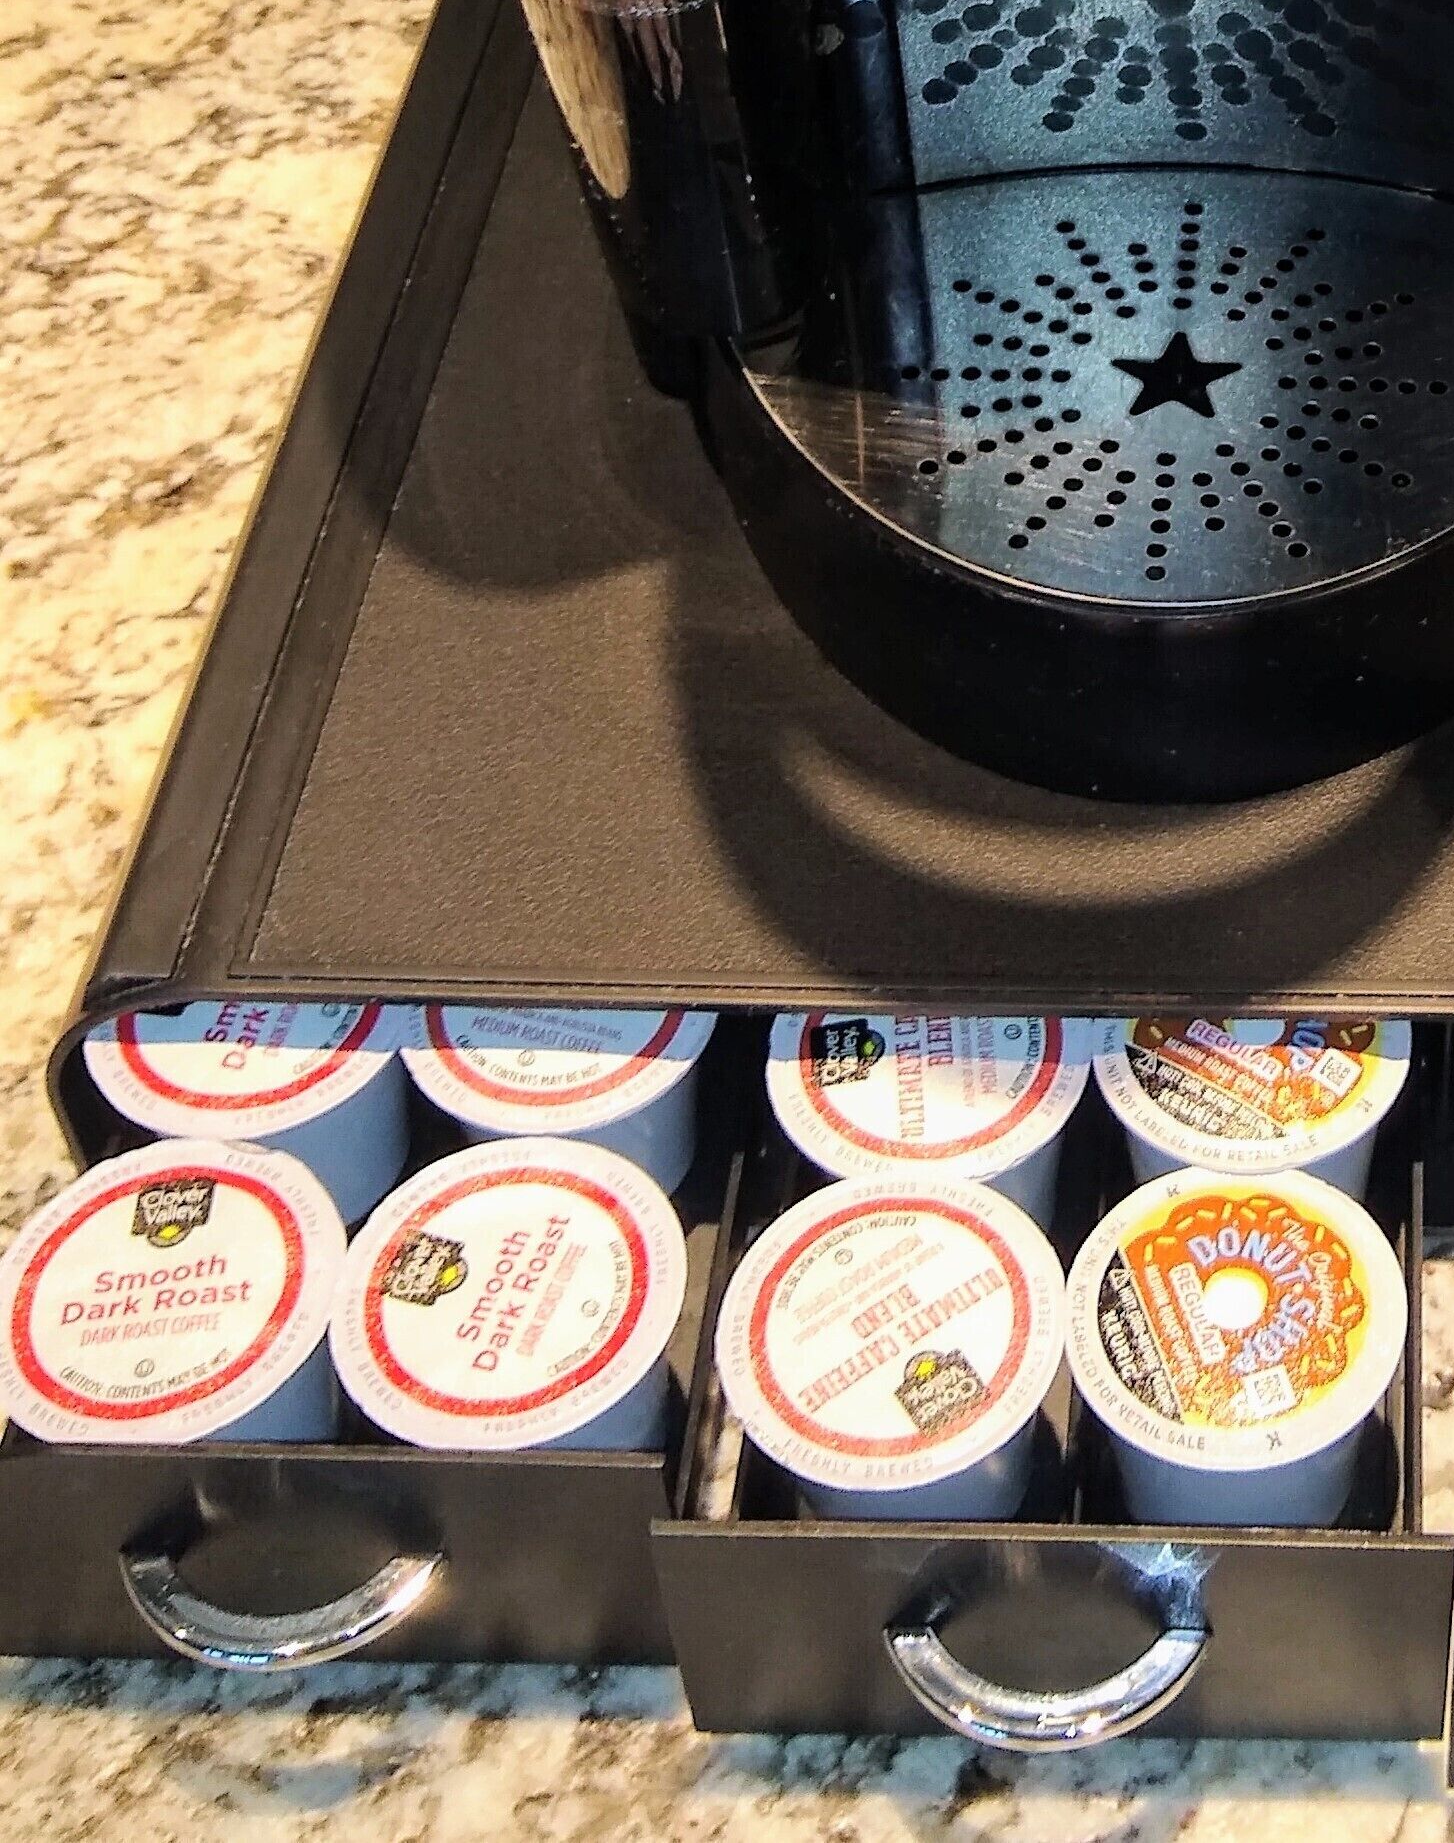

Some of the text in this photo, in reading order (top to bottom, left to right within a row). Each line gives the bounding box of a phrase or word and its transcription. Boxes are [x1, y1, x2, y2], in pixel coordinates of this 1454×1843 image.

[1190, 1020, 1278, 1076] REGULAR
[142, 1186, 207, 1207] Clover
[146, 1201, 203, 1225] Valley
[94, 1255, 228, 1294] Smooth
[456, 1230, 530, 1342] Smooth
[1187, 1225, 1314, 1288] DONUT
[60, 1282, 253, 1326] Dark Roast
[472, 1303, 525, 1372] Dark
[513, 1215, 571, 1294] Roast
[850, 1283, 921, 1339] BLEND
[898, 1267, 1004, 1345] ULTIMATE
[1174, 1266, 1221, 1357] REGULAR
[798, 1335, 901, 1414] CAFFEINE
[1101, 1308, 1140, 1382] KEURIG
[1092, 1375, 1121, 1411] FOR
